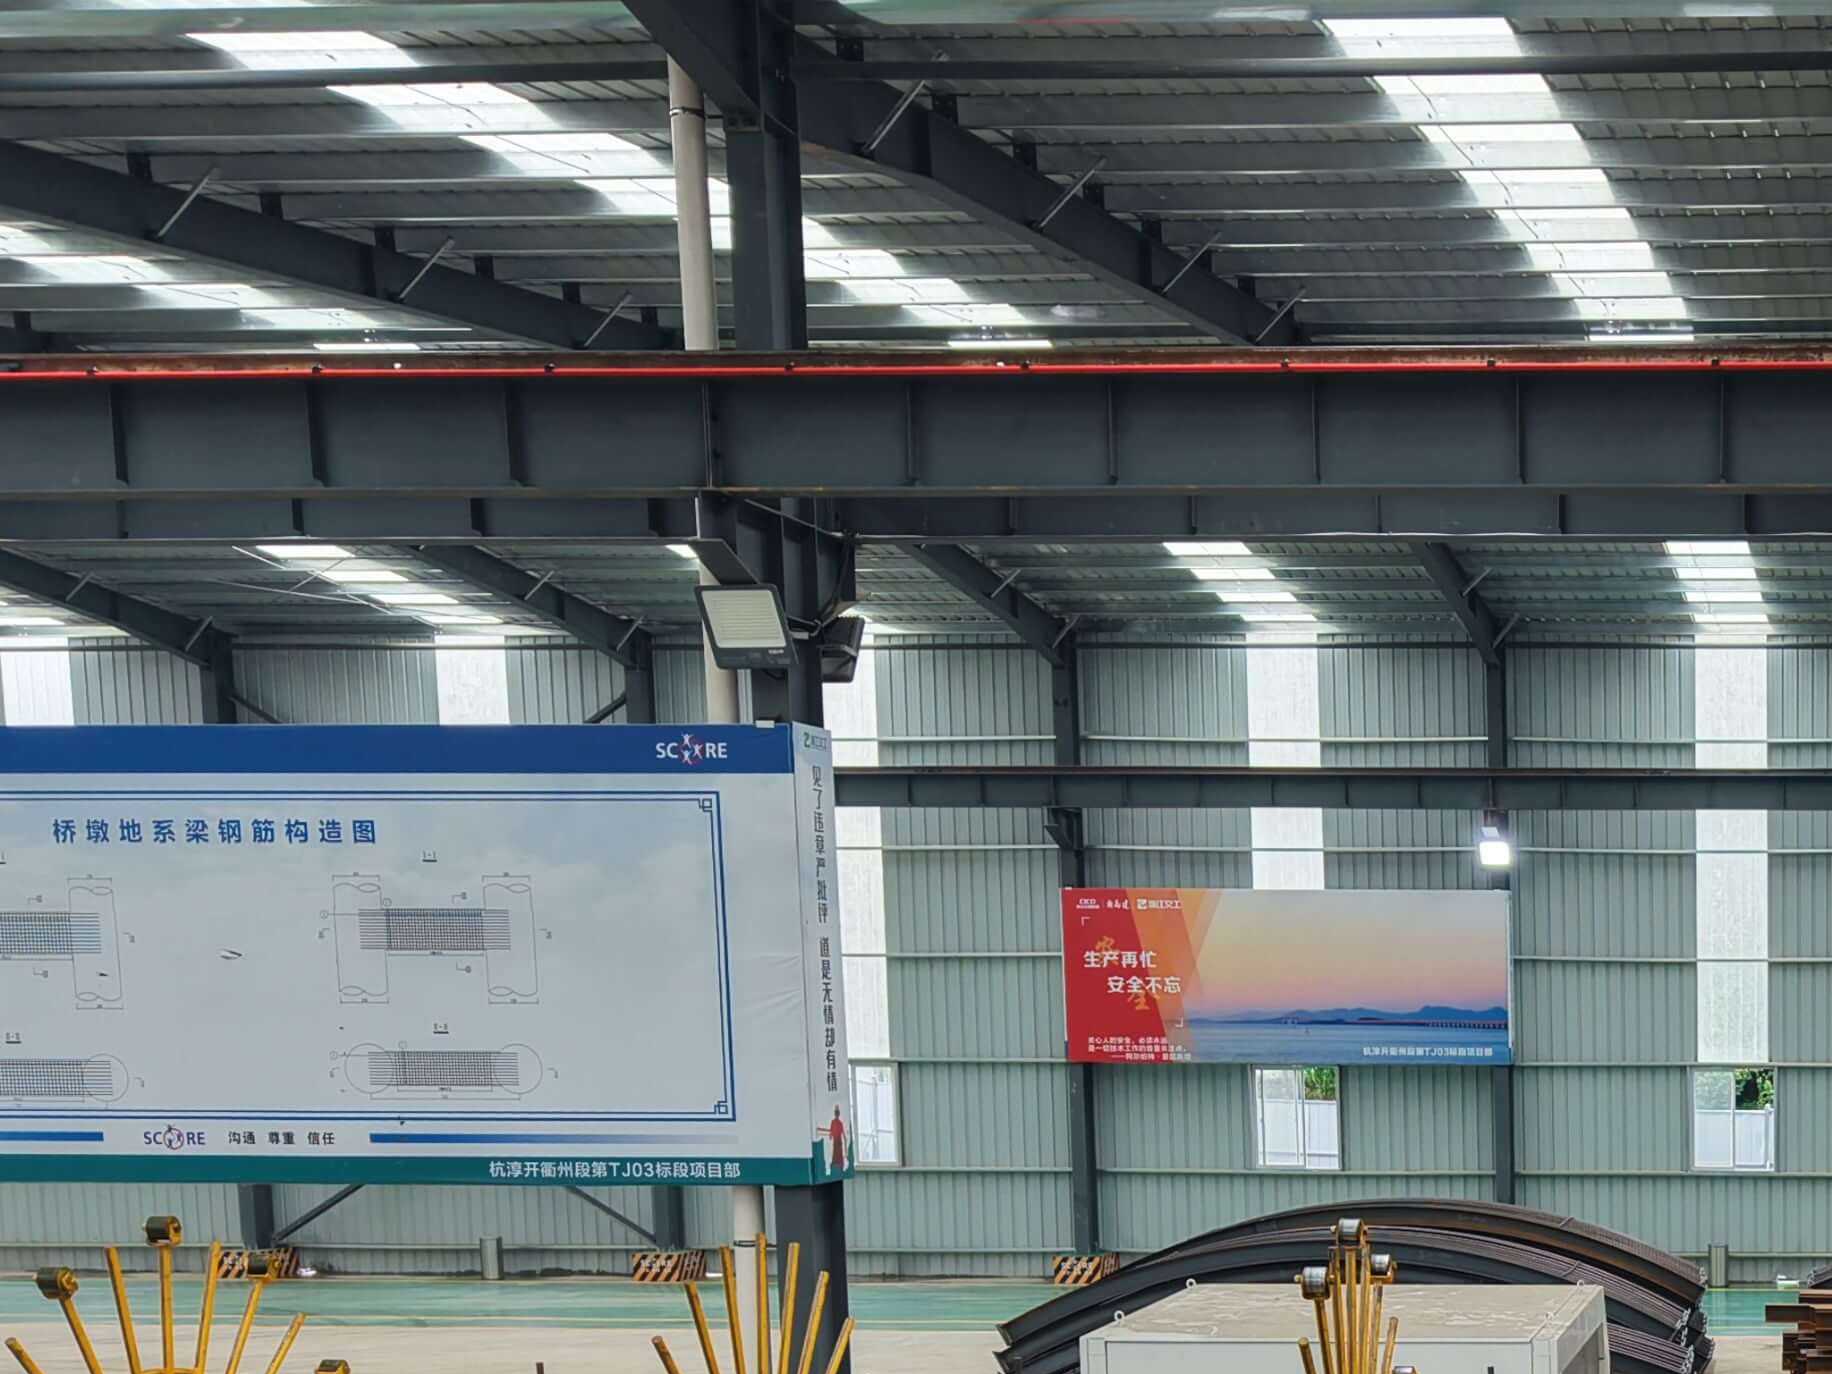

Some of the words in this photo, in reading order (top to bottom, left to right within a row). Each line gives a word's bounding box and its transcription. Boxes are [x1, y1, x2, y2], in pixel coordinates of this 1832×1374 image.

[52, 818, 378, 844] 桥墩地系梁钢筋构造图
[1083, 951, 1158, 969] 生产再忙
[1107, 976, 1181, 993] 安全不忘
[228, 1131, 256, 1145] 沟通
[268, 1131, 295, 1145] 尊重
[307, 1131, 335, 1145] 信任
[489, 1161, 740, 1178] 杭淳开衢州段第TJ03标段项目部
